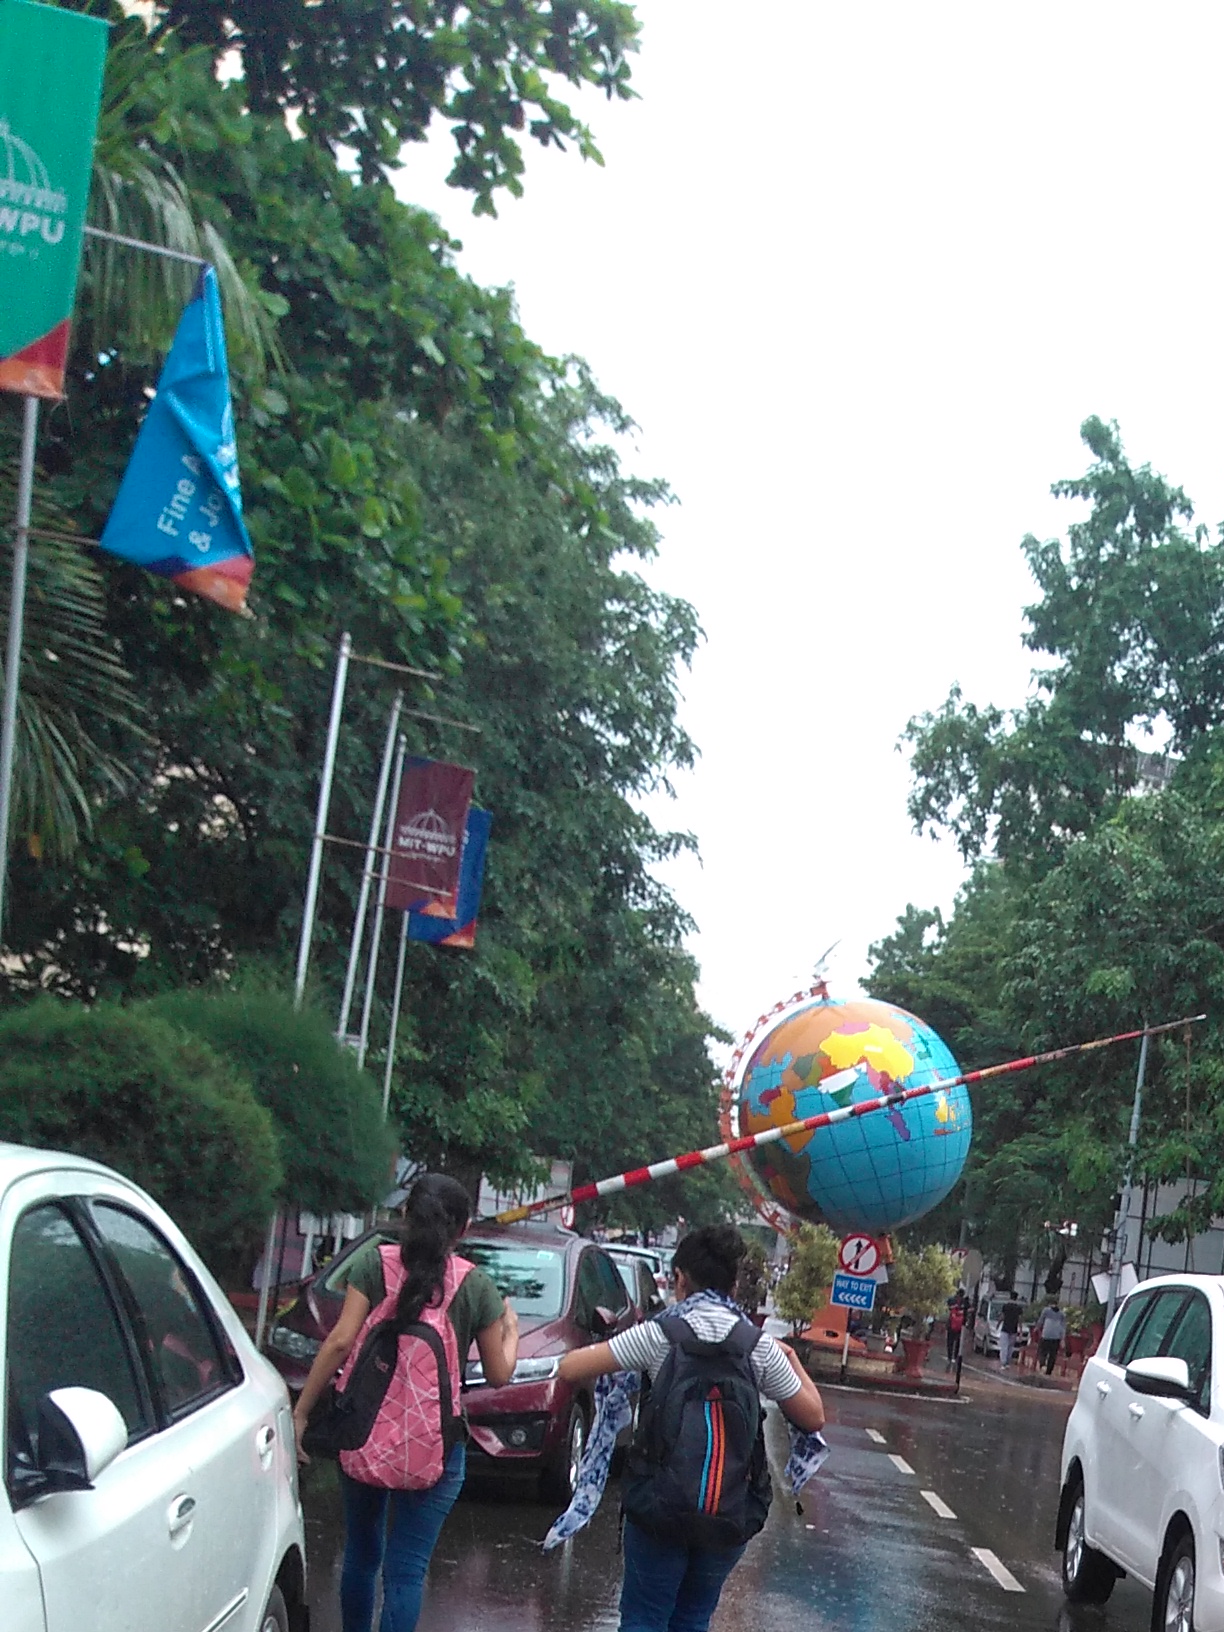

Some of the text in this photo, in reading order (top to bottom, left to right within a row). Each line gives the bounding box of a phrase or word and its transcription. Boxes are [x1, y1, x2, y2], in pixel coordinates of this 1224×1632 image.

[157, 478, 196, 537] Fine
[188, 530, 212, 553] &
[398, 835, 456, 857] MIT-WPU
[836, 1278, 873, 1293] WAY TO EXIT
